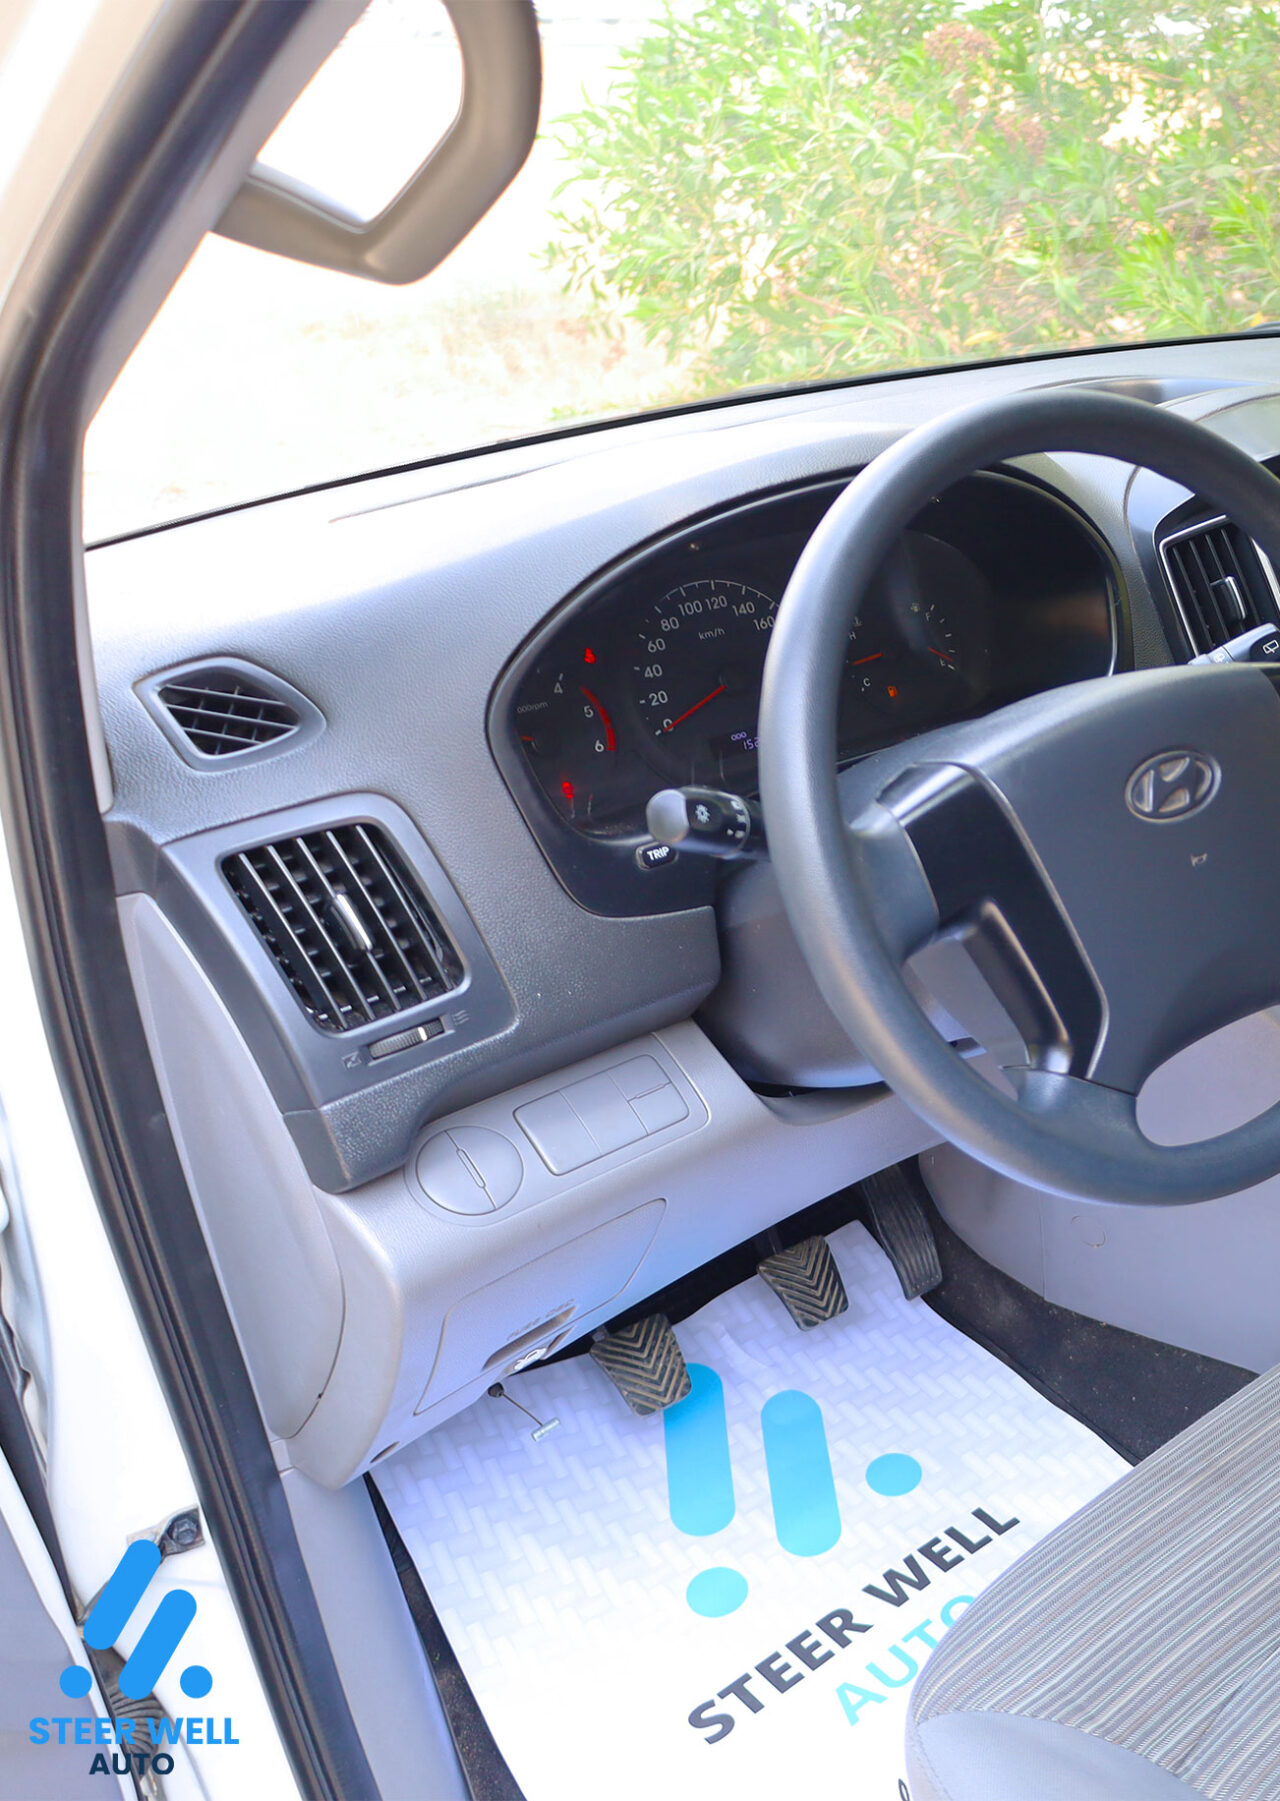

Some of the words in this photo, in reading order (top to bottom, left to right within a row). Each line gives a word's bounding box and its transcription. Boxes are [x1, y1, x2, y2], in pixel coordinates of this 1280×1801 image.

[678, 600, 703, 616] 100
[705, 595, 728, 611] 120
[732, 601, 755, 617] 140
[660, 616, 680, 631] 80
[753, 615, 776, 631] 160
[698, 627, 726, 641] km/h
[647, 638, 666, 653] 60
[644, 664, 663, 679] 40
[553, 682, 563, 694] 4
[863, 677, 871, 687] C
[649, 690, 669, 706] 20
[583, 705, 594, 718] 5
[594, 739, 605, 752] 6
[646, 845, 670, 862] TRIP
[687, 1607, 874, 1745] STEER
[861, 1507, 1021, 1608] WELL
